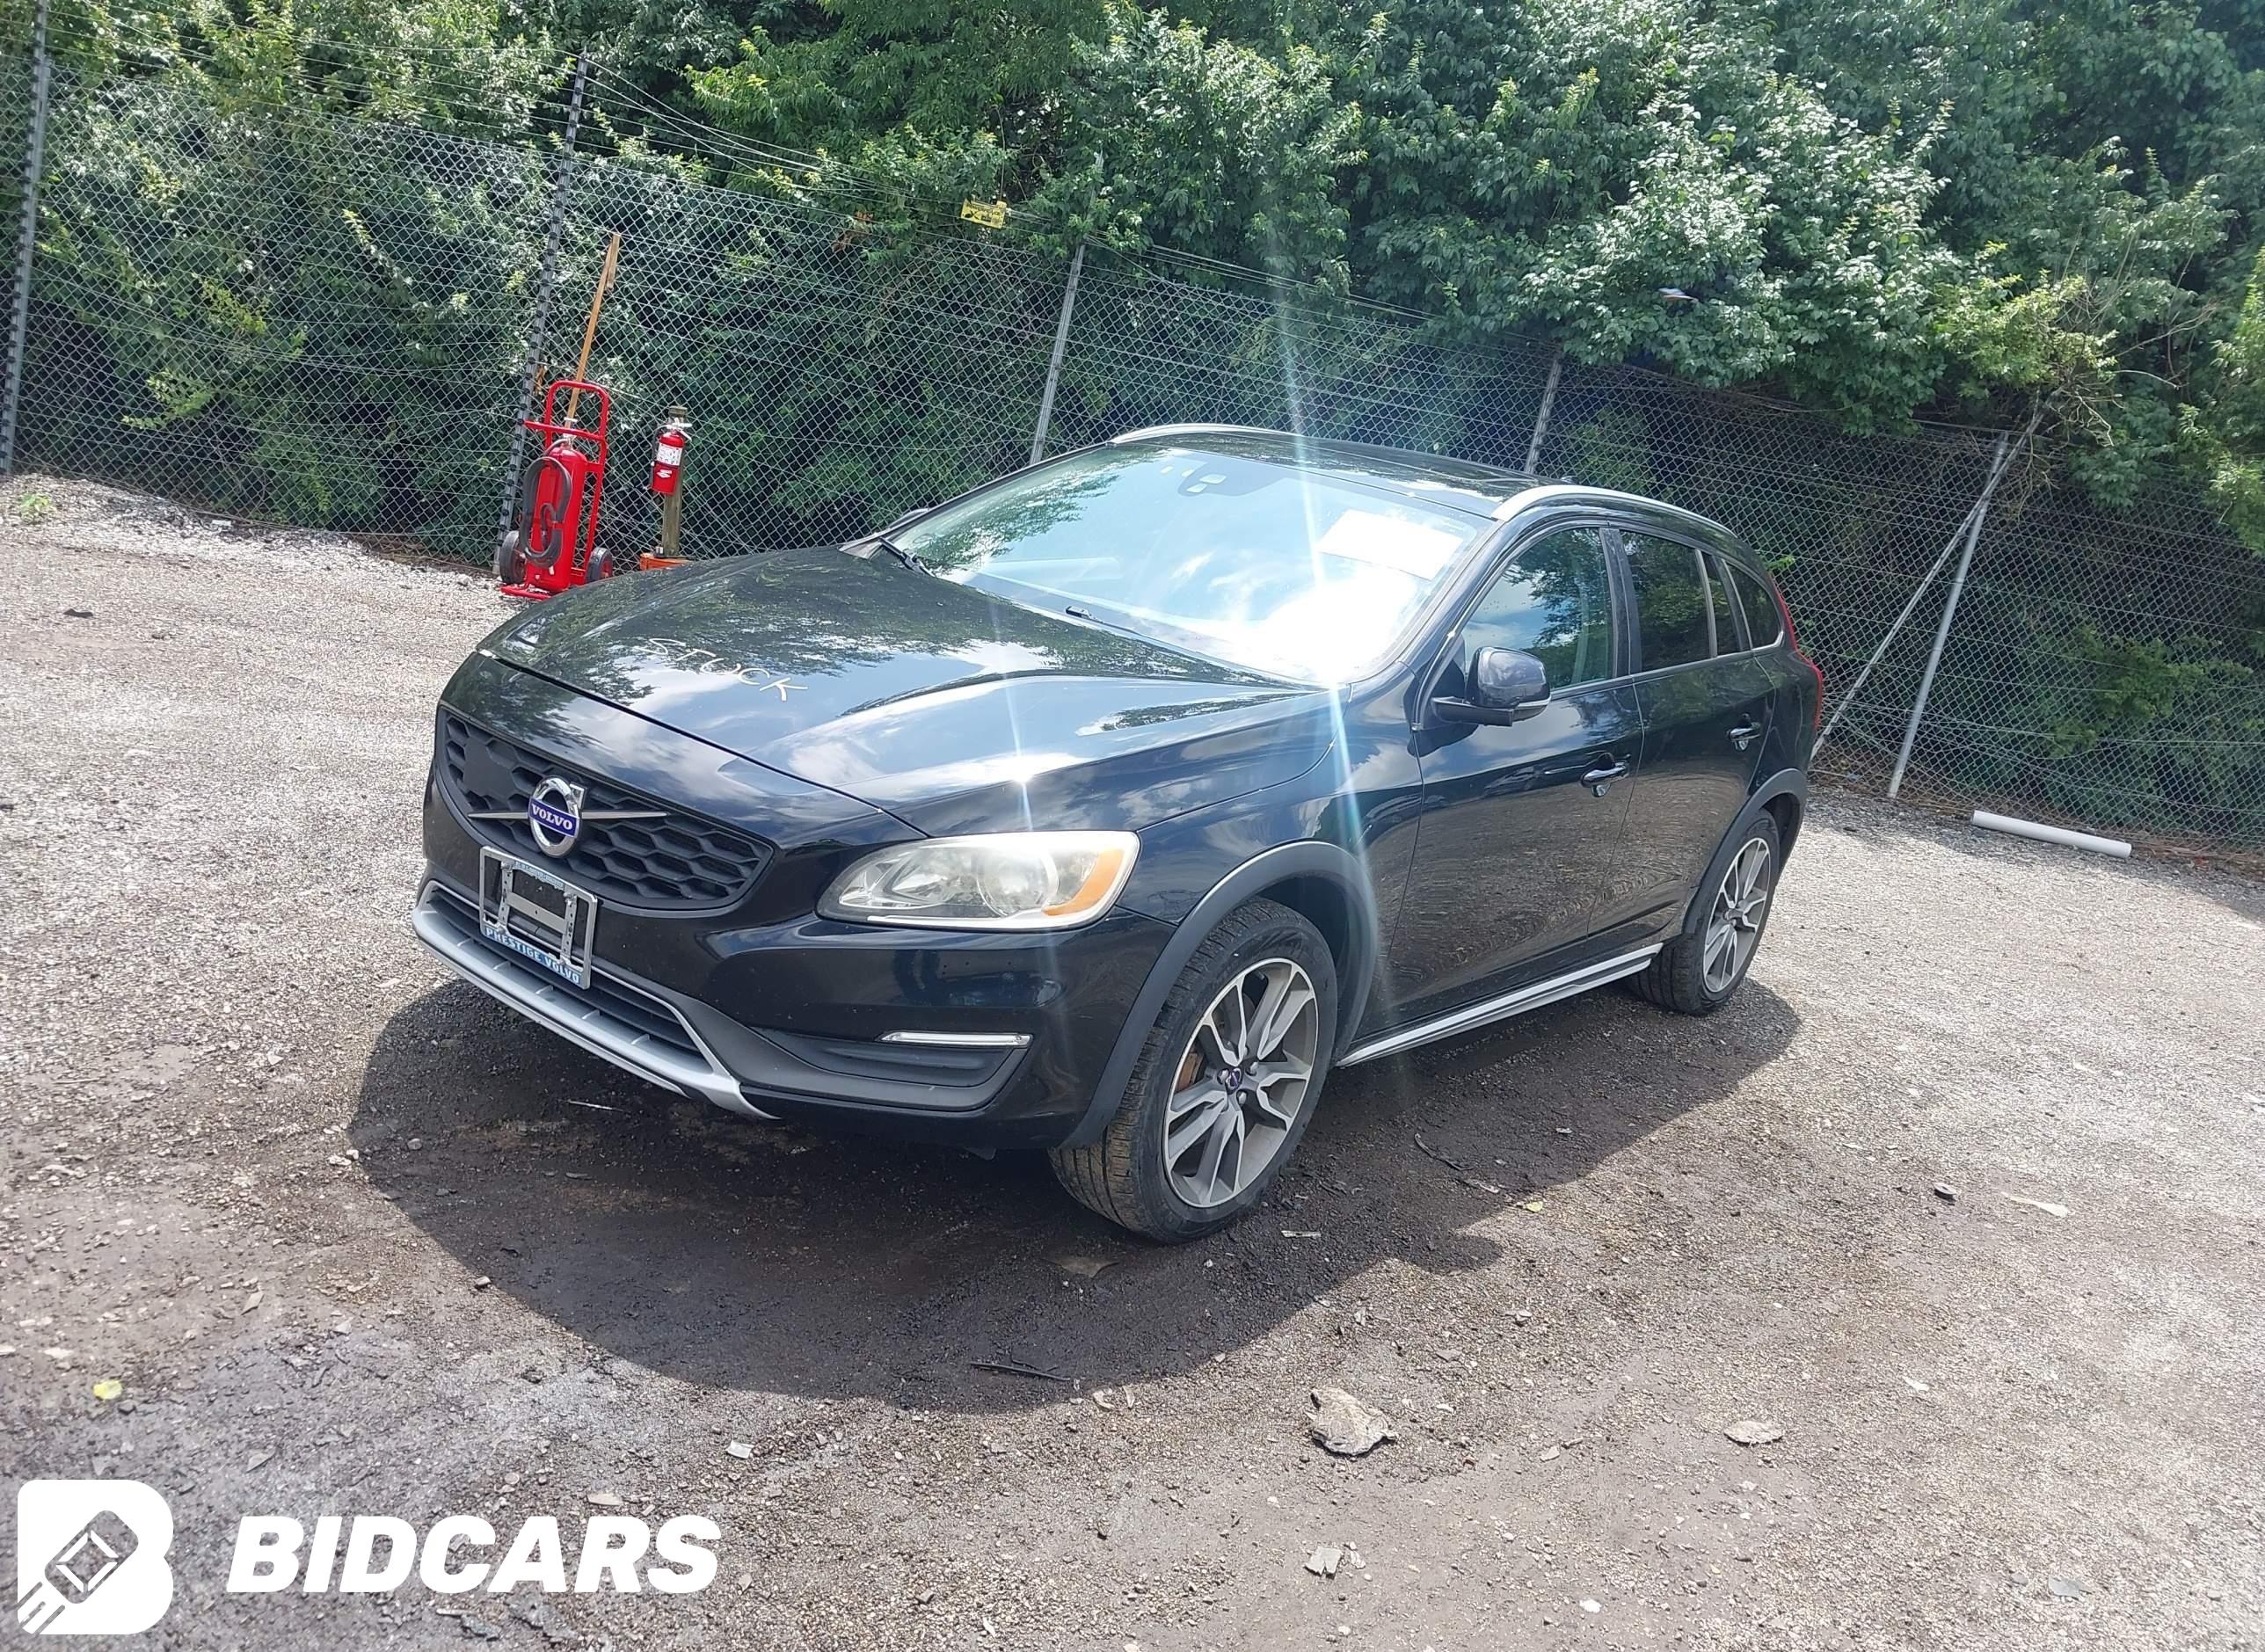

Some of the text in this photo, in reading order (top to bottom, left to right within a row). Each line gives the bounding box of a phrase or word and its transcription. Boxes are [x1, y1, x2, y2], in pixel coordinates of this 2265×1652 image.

[632, 637, 809, 702] STUCK
[531, 803, 573, 830] VOLVO
[486, 927, 579, 984] PRESTIGE VOLVO
